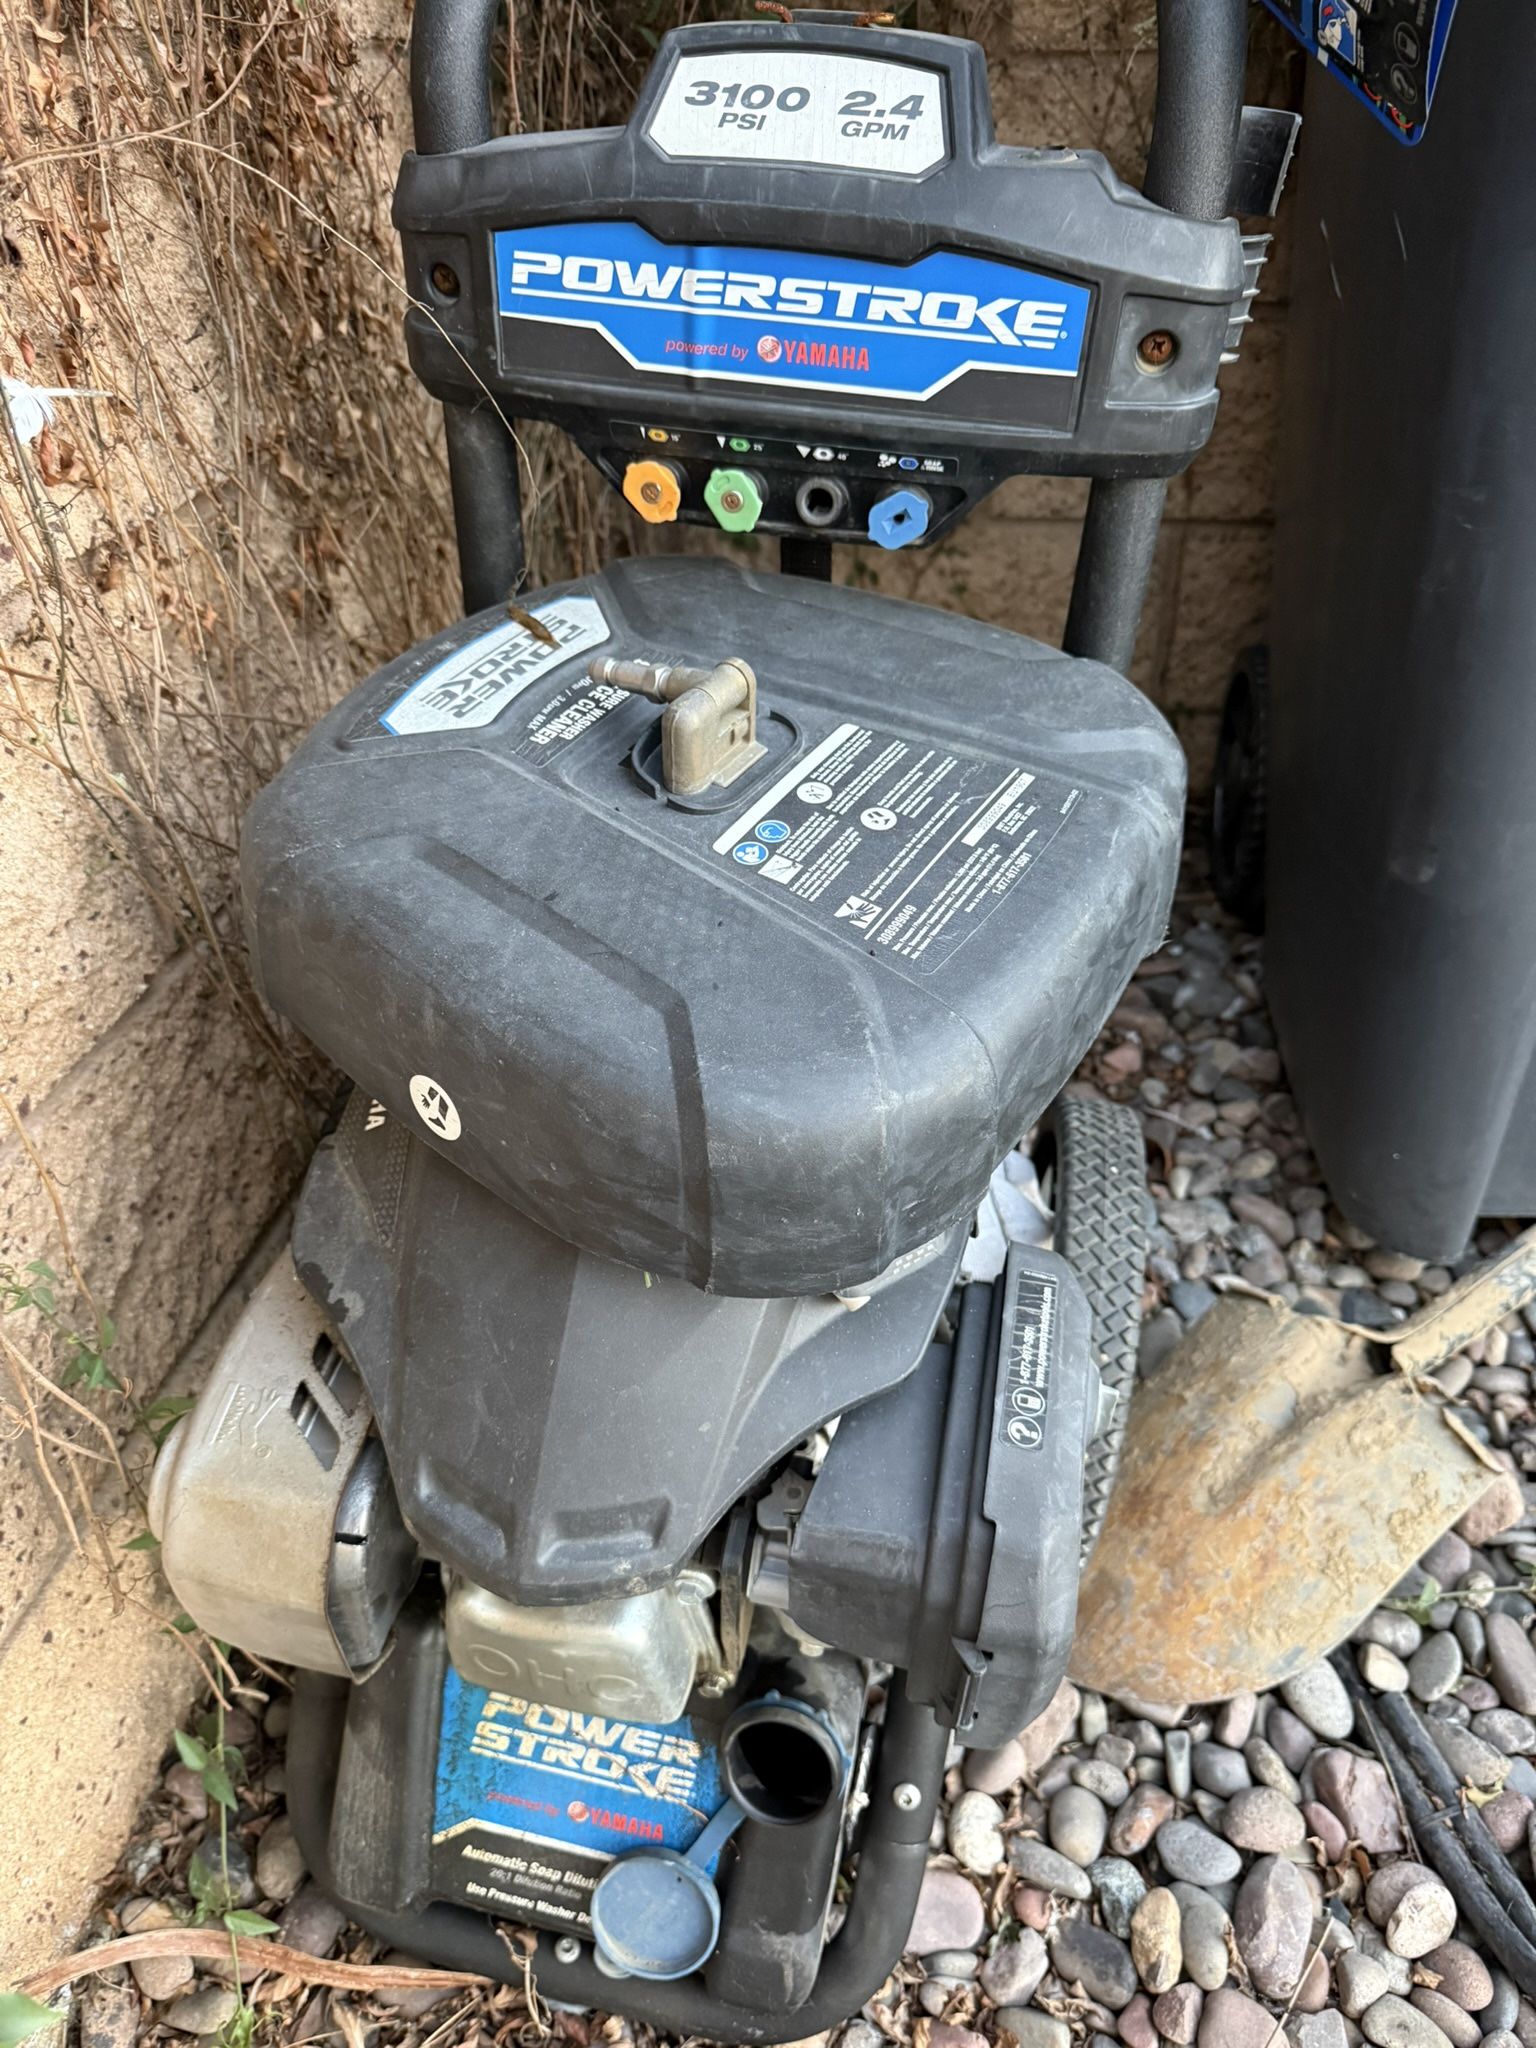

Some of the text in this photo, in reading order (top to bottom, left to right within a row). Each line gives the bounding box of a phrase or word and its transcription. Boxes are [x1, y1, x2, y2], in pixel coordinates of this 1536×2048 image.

[684, 80, 925, 121] 3100 2.4
[718, 112, 910, 141] PSI GPM
[511, 250, 1067, 349] POWERSTROKE
[665, 339, 870, 371] powered by YAMAHA
[452, 623, 588, 719] POWER
[527, 713, 547, 731] MAX
[529, 698, 596, 745] CLEANER
[559, 688, 631, 740] SURE WASHER
[877, 904, 917, 946] 308999049
[481, 1691, 701, 1768] POWER
[470, 1720, 697, 1803] STROKE
[590, 1807, 664, 1840] YAMAHA
[461, 1844, 600, 1890] Automatic Soap Diluti
[513, 1874, 554, 1892] Dilution
[555, 1884, 583, 1900] Ratio
[466, 1882, 487, 1896] Use
[487, 1887, 536, 1909] Pressure
[535, 1900, 577, 1920] Washer
